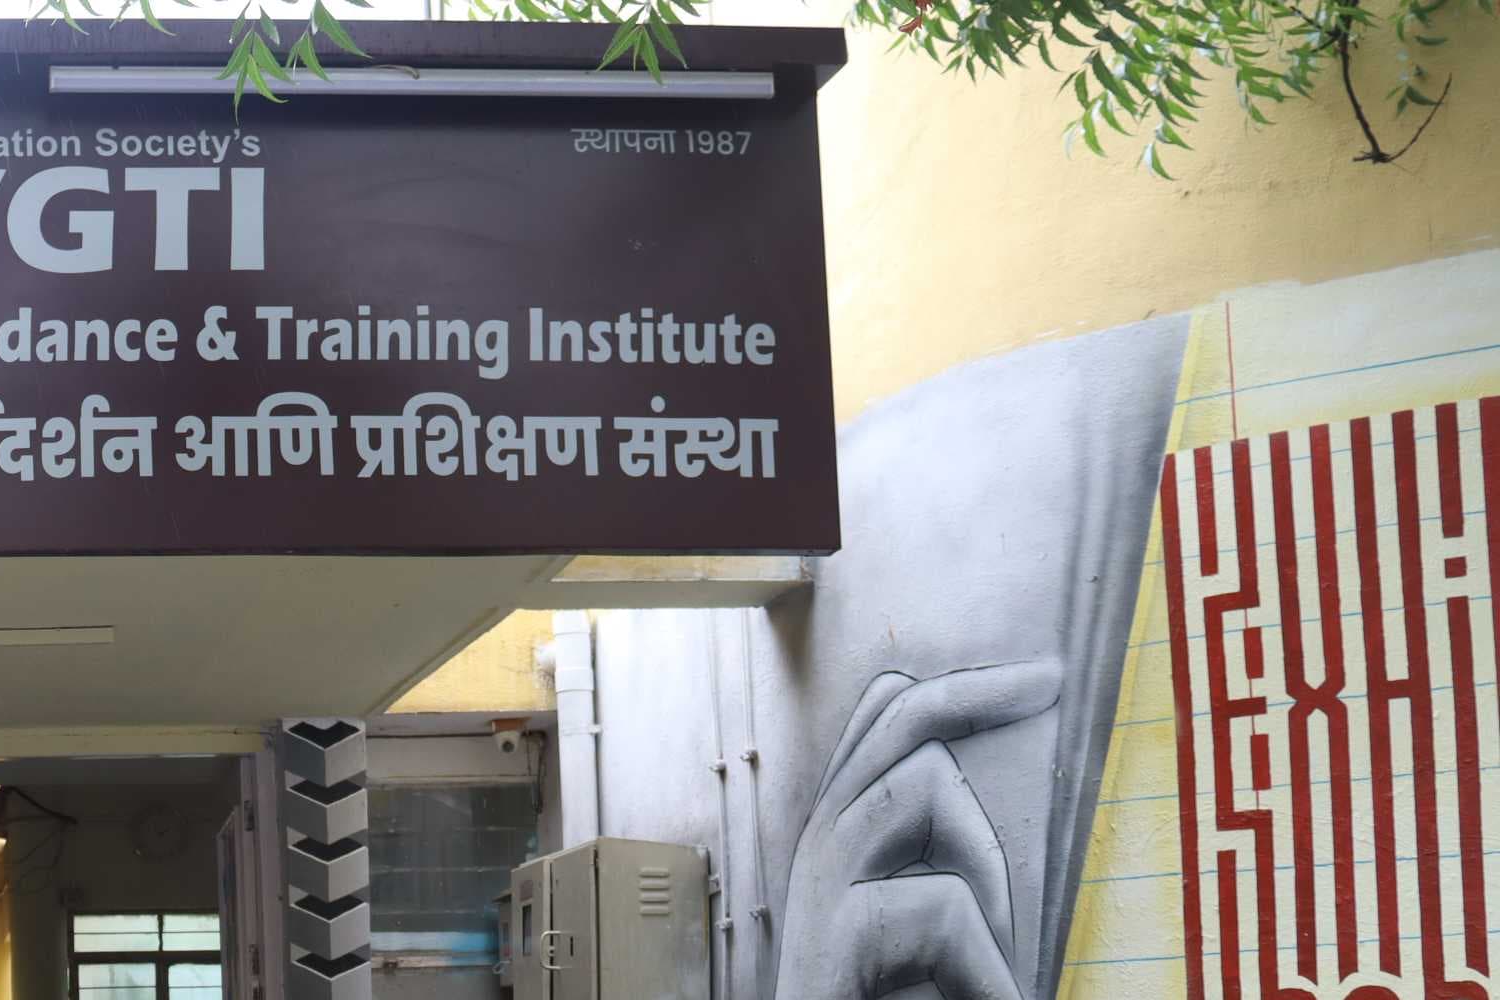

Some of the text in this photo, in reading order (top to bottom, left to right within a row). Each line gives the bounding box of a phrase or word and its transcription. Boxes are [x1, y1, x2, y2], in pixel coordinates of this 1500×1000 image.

[94, 126, 261, 164] Society's
[571, 127, 752, 156] स्थापना 1987
[195, 305, 240, 362] &
[255, 304, 509, 380] Training
[528, 307, 776, 366] Institute
[174, 391, 338, 477] आणि
[350, 391, 602, 482] प्रशिक्षण
[613, 395, 779, 478] संस्था
